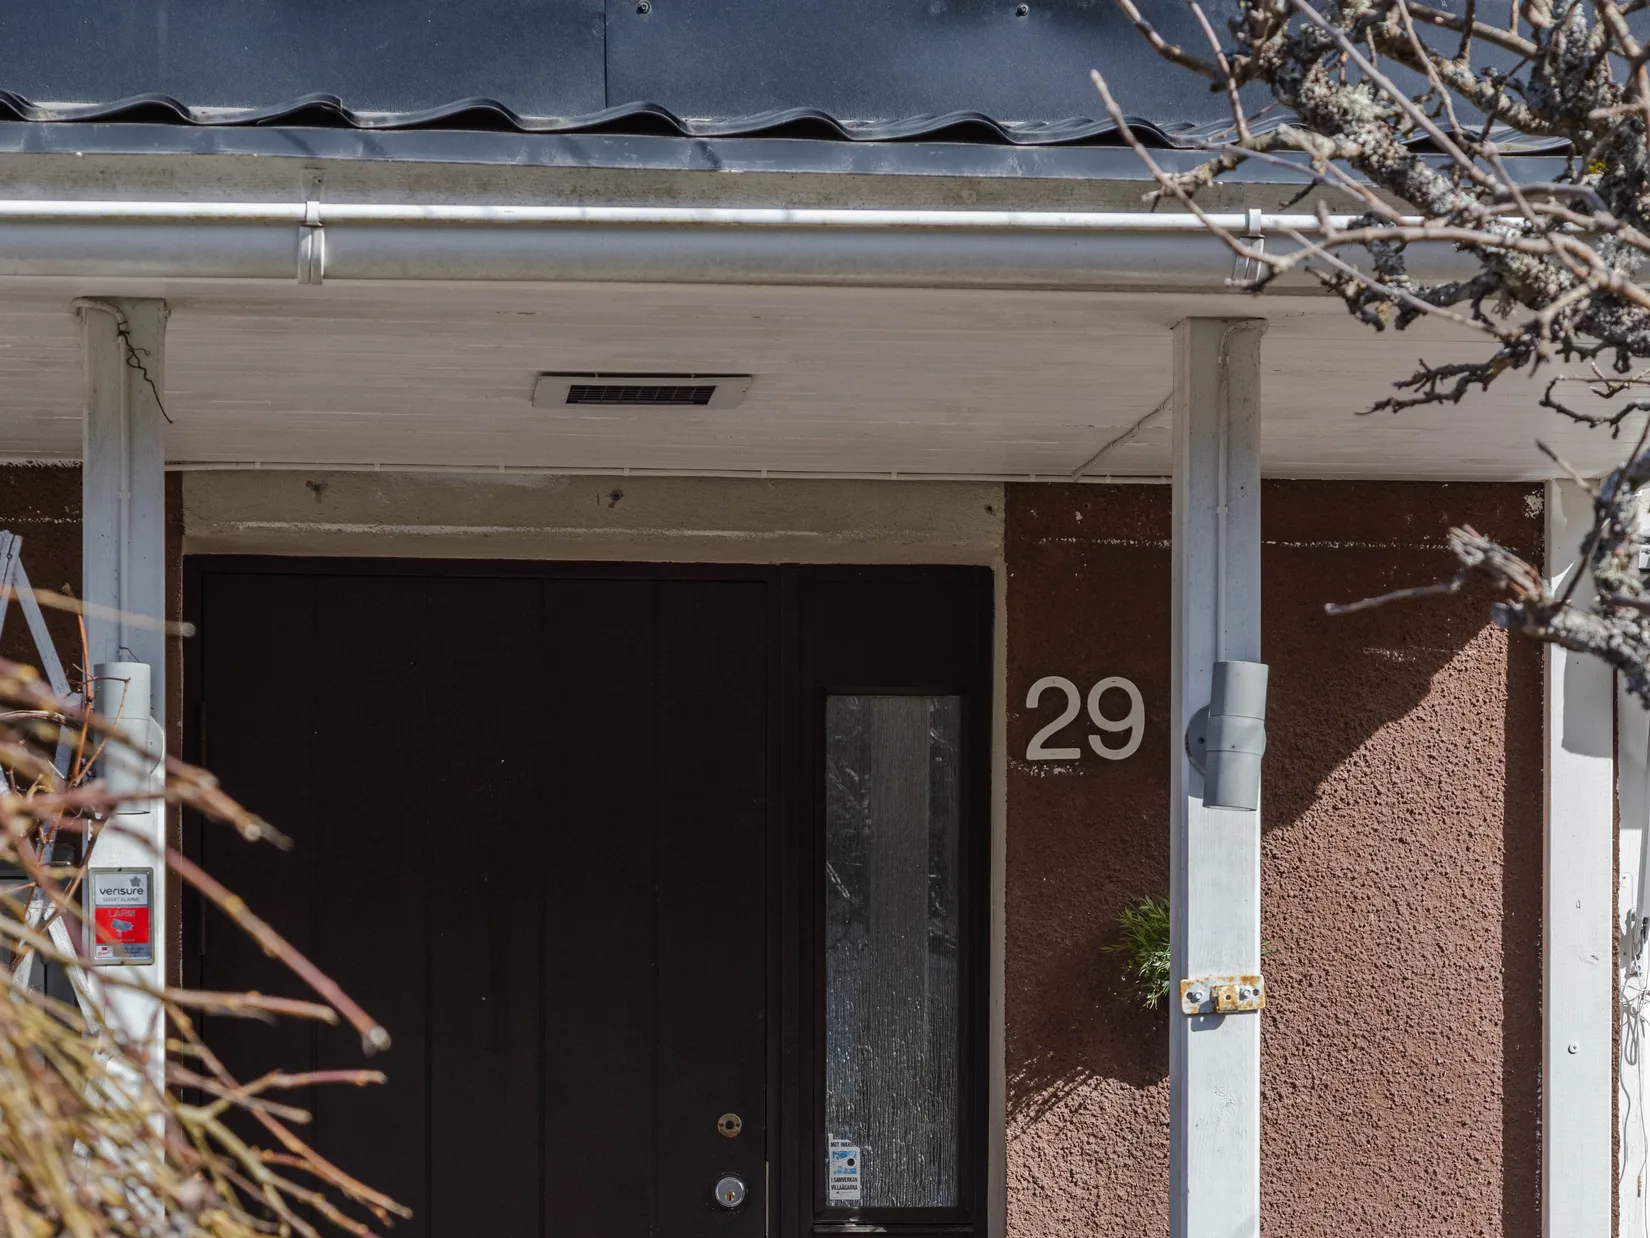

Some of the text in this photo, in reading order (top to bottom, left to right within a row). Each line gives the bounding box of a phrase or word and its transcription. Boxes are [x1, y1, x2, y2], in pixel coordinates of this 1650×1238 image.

[1025, 675, 1146, 761] 29
[99, 887, 144, 896] verisure
[108, 909, 136, 917] LARM
